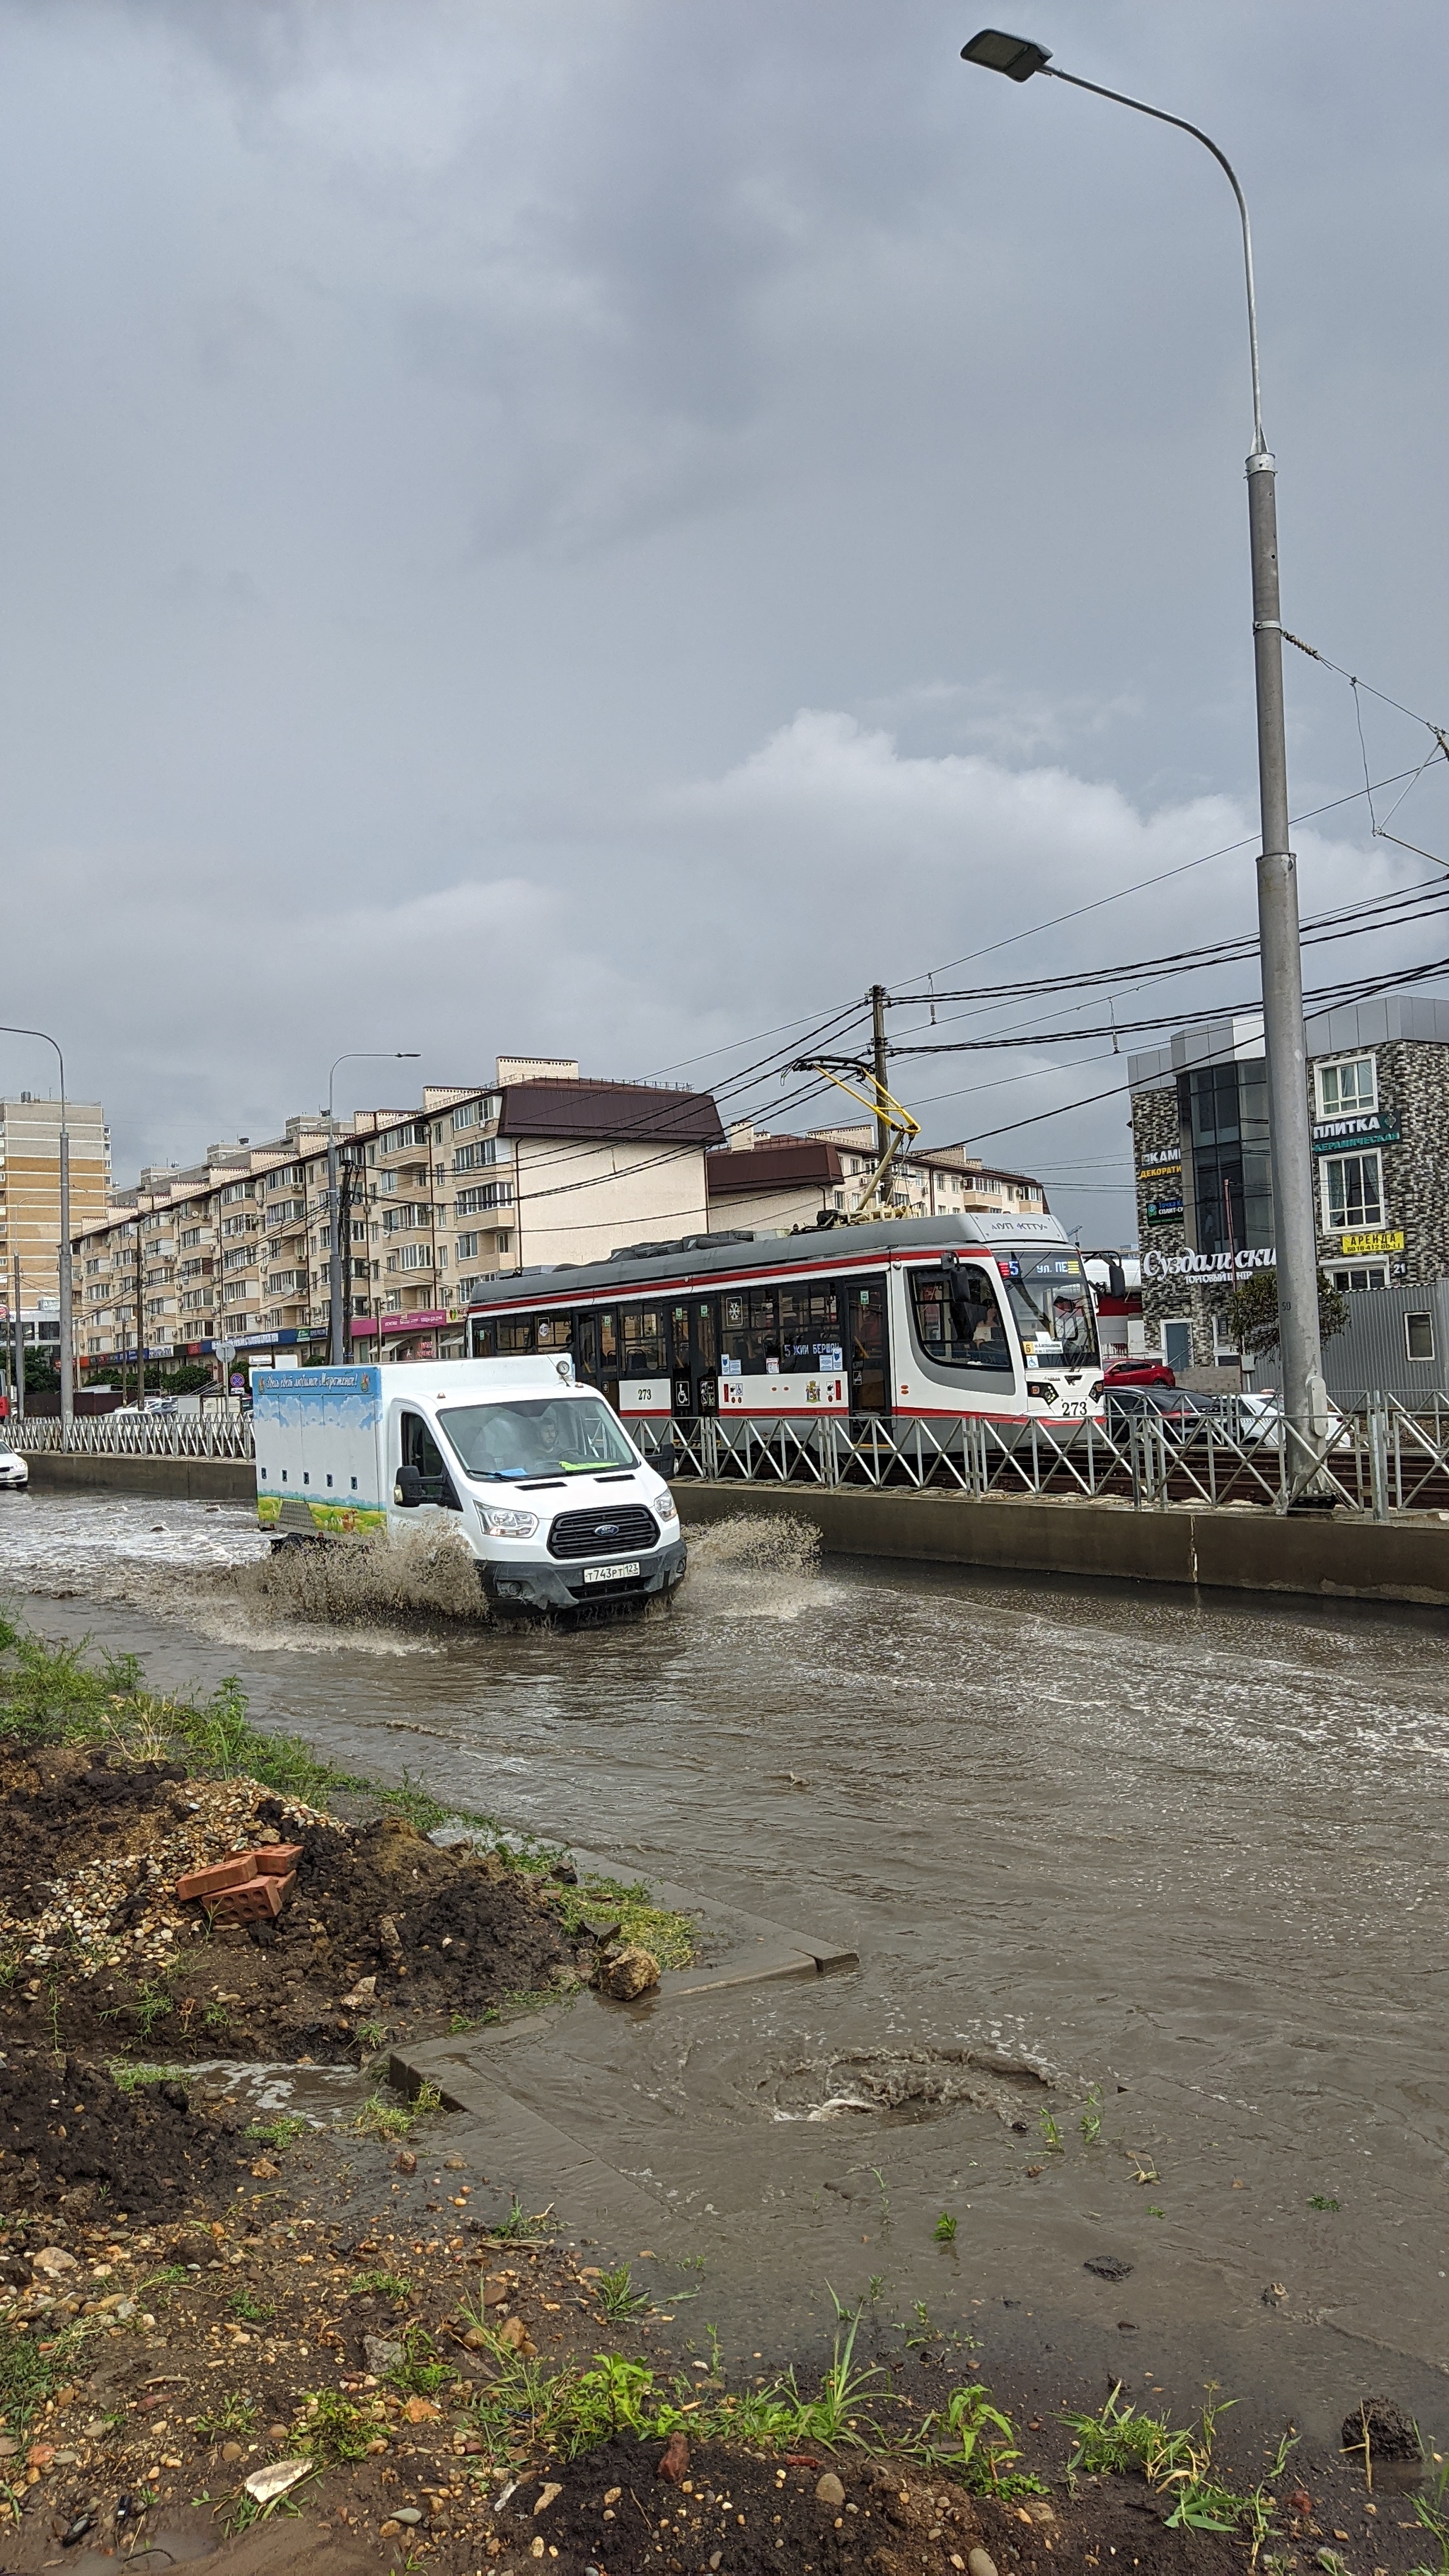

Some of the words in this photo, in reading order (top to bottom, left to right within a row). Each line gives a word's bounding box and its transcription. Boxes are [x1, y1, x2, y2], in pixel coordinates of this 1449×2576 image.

[1313, 1116, 1381, 1139] ПЛИТКА
[1351, 1233, 1396, 1246] АРЕНДА
[1009, 1261, 1019, 1276] 5
[1037, 1264, 1052, 1273] ул.
[1393, 1263, 1406, 1273] 21
[1185, 1274, 1227, 1284] ТОРГОВЫЙ
[1228, 1271, 1253, 1282] ЦНТР
[784, 1344, 791, 1357] 5
[1025, 1344, 1031, 1353] 5
[637, 1389, 652, 1400] 273
[1061, 1402, 1087, 1416] 273
[624, 1564, 638, 1573] 123
